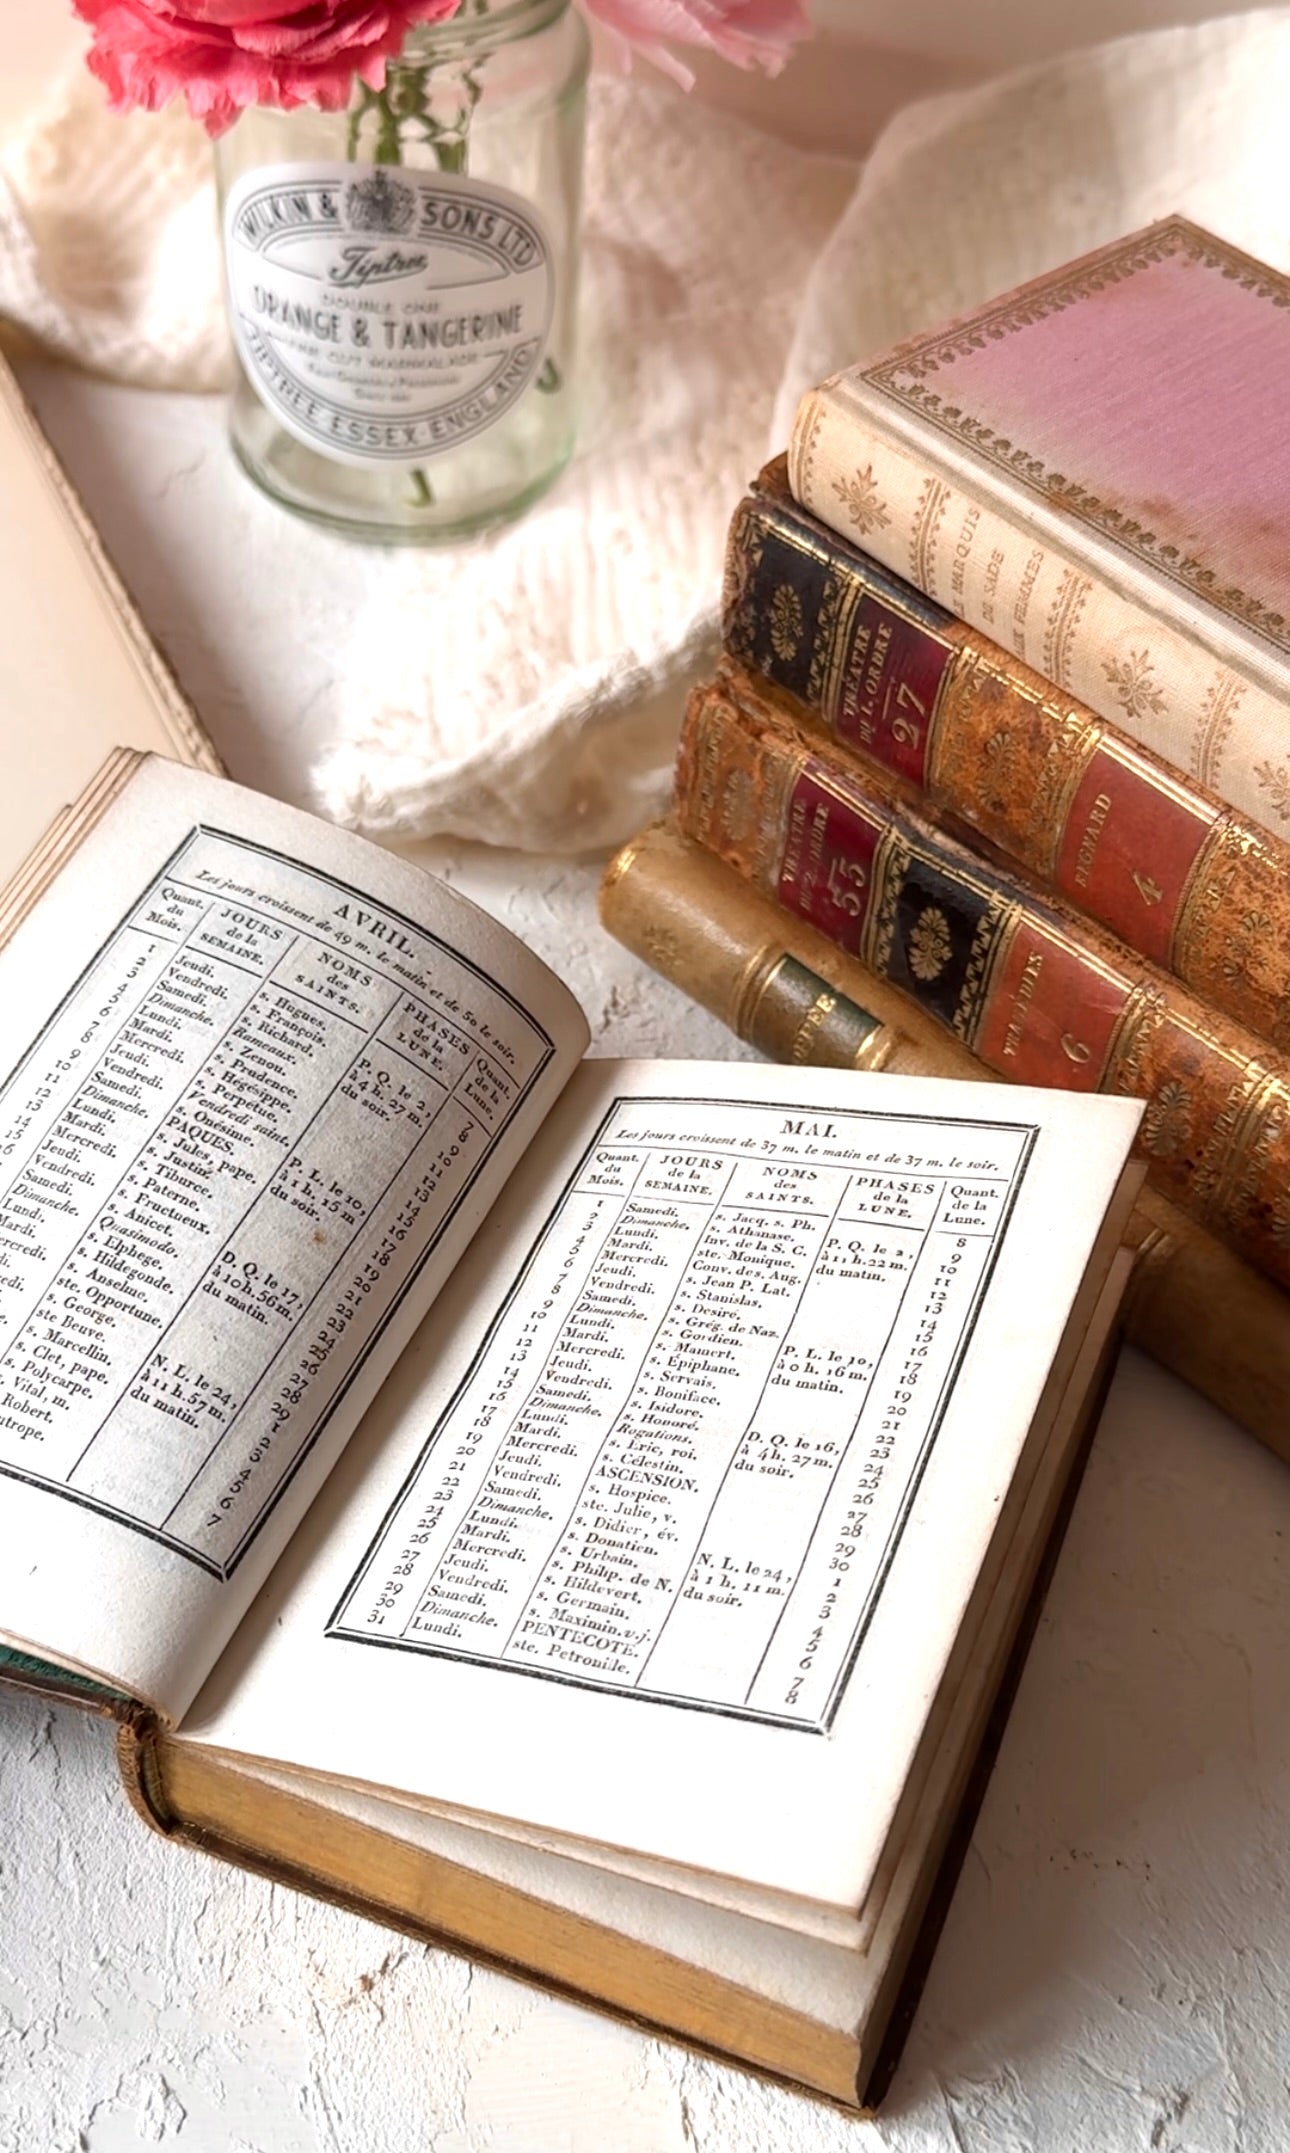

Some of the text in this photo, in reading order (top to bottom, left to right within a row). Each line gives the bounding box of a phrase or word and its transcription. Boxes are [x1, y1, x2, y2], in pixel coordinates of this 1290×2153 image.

[318, 193, 337, 218] &
[420, 202, 495, 239] SONS
[498, 225, 535, 266] LTD
[329, 245, 428, 288] Tiptree
[351, 317, 370, 348] &
[382, 304, 522, 350] TANGERINE
[330, 416, 418, 446] ESSEX
[429, 350, 531, 440] ENGLAND
[951, 508, 981, 595] MARQUIS
[984, 550, 1005, 596] SADE
[864, 621, 893, 695] ORDRE
[891, 682, 927, 751] 27
[831, 857, 866, 917] 55
[1132, 872, 1163, 907] 4
[161, 887, 204, 910] Quant.
[145, 910, 182, 932] Mois.
[166, 904, 185, 917] du
[220, 908, 284, 941] JOURS
[332, 904, 415, 959] AVRIL.
[225, 926, 258, 947] de la
[199, 932, 264, 966] SEMAINE.
[174, 954, 215, 979] Jeudi.
[194, 869, 221, 885] Les
[216, 878, 257, 897] jours
[257, 893, 316, 925] croissent
[314, 920, 333, 933] de
[333, 931, 353, 946] 49
[354, 941, 372, 956] m.
[375, 951, 390, 964] le
[391, 963, 429, 990] matin
[429, 989, 444, 1000] et
[443, 999, 460, 1013] de
[479, 1024, 492, 1039] le
[491, 1039, 515, 1065] soir.
[316, 951, 373, 987] NOMS
[168, 966, 229, 1001] Vendredi.
[326, 973, 350, 991] des
[156, 979, 208, 1008] Samedi.
[294, 974, 364, 1014] SAINTS.
[402, 1001, 471, 1056] PHASES
[395, 1031, 443, 1072] LUNE.
[1060, 1032, 1091, 1065] 6
[165, 1115, 235, 1156] PAQUES.
[779, 1119, 838, 1139] MAI.
[596, 1151, 640, 1164] Quant.
[615, 1129, 999, 1172] Les jours croissent de 37 m. le matin et de 37 m. le soir.
[604, 1163, 622, 1173] du
[659, 1154, 724, 1171] JOURS
[586, 1174, 624, 1187] Mois.
[667, 1167, 701, 1180] de la
[761, 1166, 818, 1181] NOMS
[773, 1178, 797, 1189] des
[644, 1179, 713, 1196] SEMAINE.
[855, 1176, 936, 1195] PHASES
[950, 1185, 998, 1200] Quant.
[744, 1191, 814, 1205] SAINTS.
[872, 1191, 909, 1205] de la
[951, 1199, 987, 1211] de la
[625, 1202, 679, 1218] Samedi.
[857, 1202, 912, 1219] LUNE.
[942, 1212, 986, 1226] Lune.
[613, 1225, 659, 1240] Lundi.
[732, 1212, 769, 1228] Jacq.
[790, 1218, 816, 1232] Ph.
[99, 1215, 179, 1259] Quasimodo.
[726, 1225, 795, 1243] Athanase.
[955, 1237, 968, 1248] 8
[563, 1256, 576, 1269] 6
[600, 1249, 669, 1268] Mercredi.
[696, 1248, 796, 1269] ste. Monique.
[950, 1253, 963, 1265] 9
[594, 1262, 636, 1278] Jeudi.
[815, 1263, 886, 1283] du matin.
[939, 1264, 958, 1275] 10
[591, 1275, 656, 1295] Vendredi.
[63, 1296, 117, 1328] George.
[201, 1280, 269, 1326] du matin.
[515, 1337, 533, 1348] 12
[150, 1352, 169, 1373] N.
[172, 1363, 193, 1383] L.
[193, 1373, 210, 1391] le
[770, 1373, 844, 1395] du matin.
[129, 1385, 199, 1429] du matin.
[887, 1405, 908, 1417] 20
[615, 1422, 693, 1445] Rogations.
[747, 1431, 764, 1444] D.
[769, 1433, 789, 1449] Q.
[794, 1436, 811, 1450] le
[875, 1434, 896, 1446] 22
[594, 1464, 699, 1494] ASCENSION.
[733, 1458, 795, 1479] du soir.
[408, 1531, 432, 1545] 26
[452, 1537, 527, 1563] Mercredi.
[696, 1552, 715, 1569] N.
[720, 1556, 740, 1573] L.
[744, 1560, 761, 1576] le
[682, 1585, 743, 1608] du soir.
[366, 1609, 386, 1625] 31
[419, 1600, 499, 1628] Dimanche.
[817, 1604, 832, 1620] 3
[411, 1616, 462, 1639] Lundi.
[511, 1639, 539, 1655] ste.
[520, 1619, 639, 1658] PENTECOTE.
[798, 1655, 814, 1671] 6
